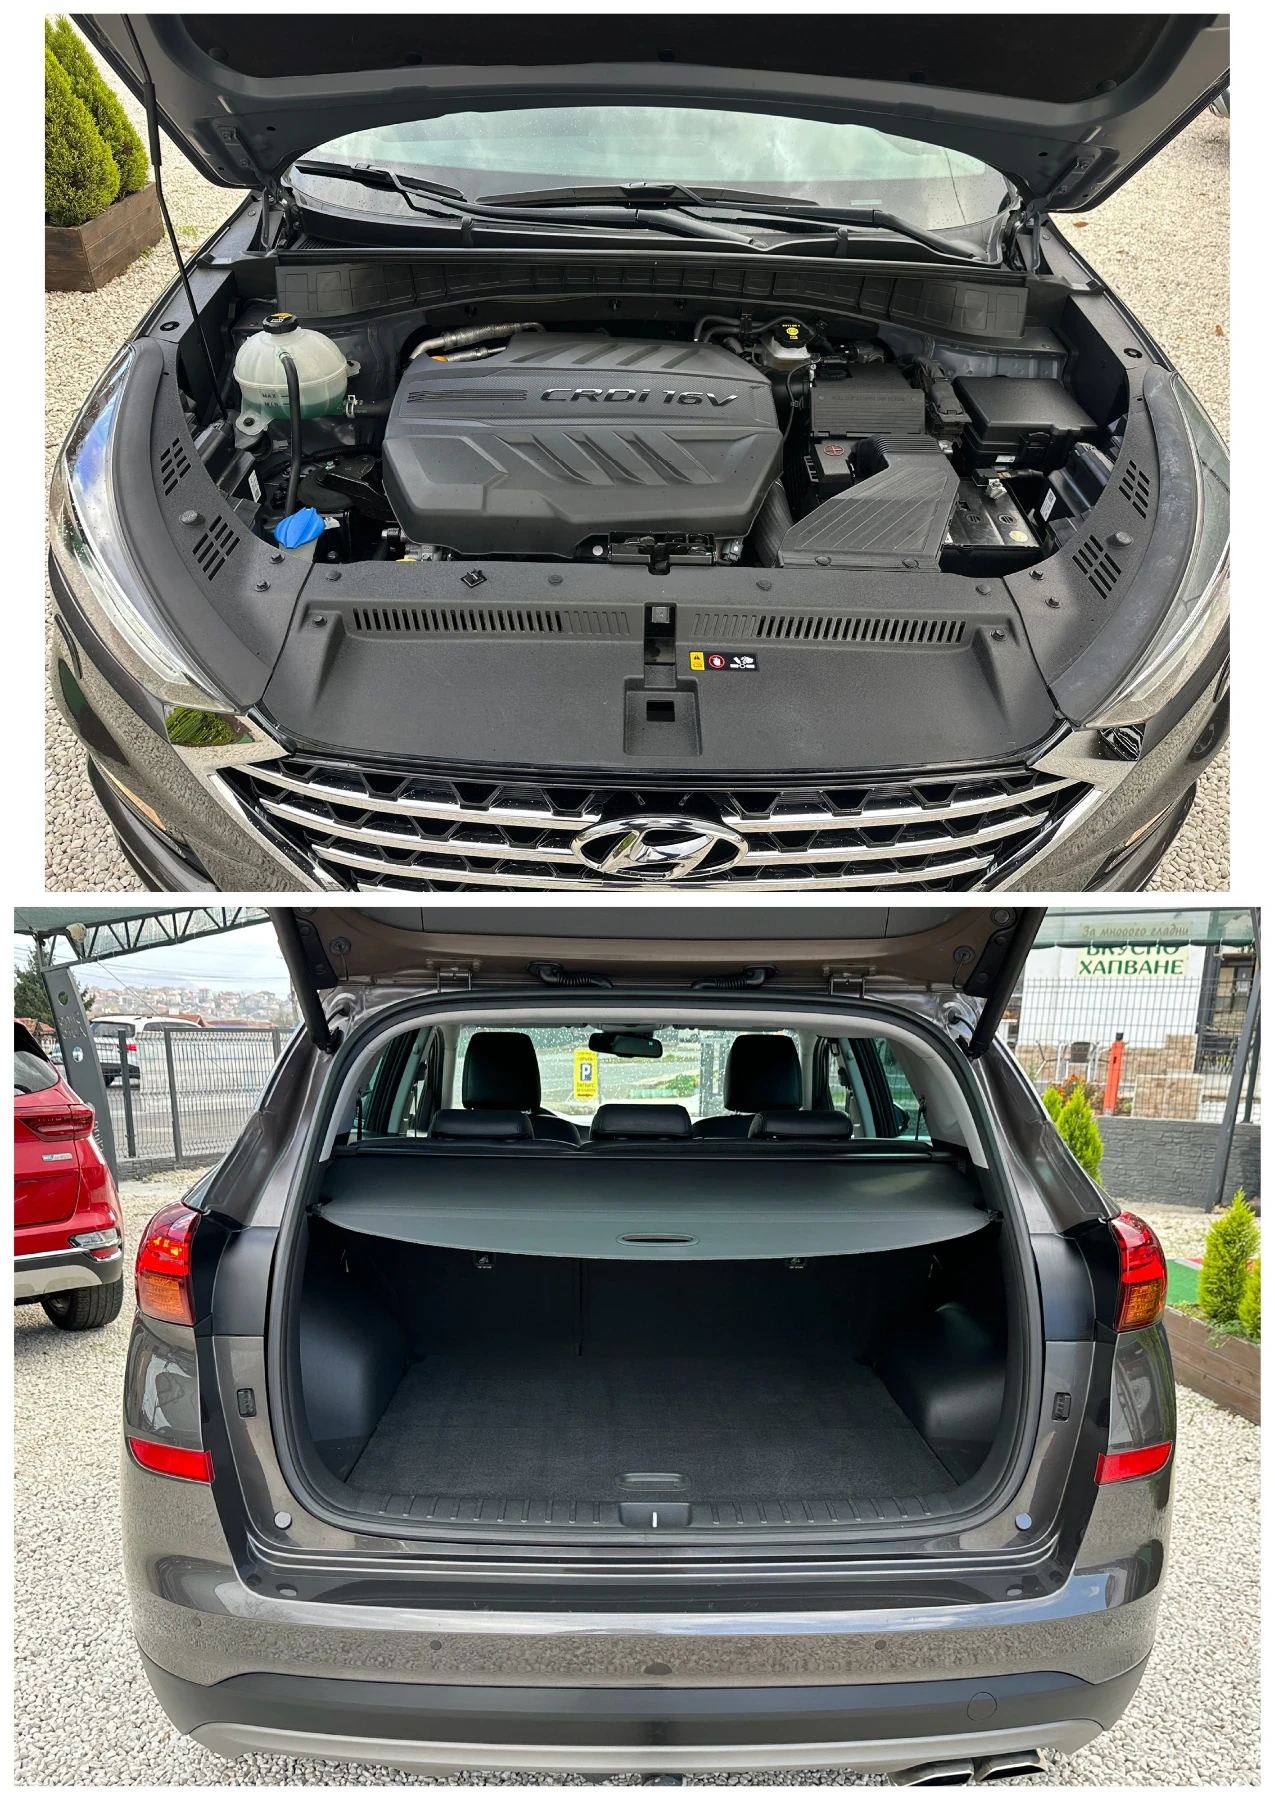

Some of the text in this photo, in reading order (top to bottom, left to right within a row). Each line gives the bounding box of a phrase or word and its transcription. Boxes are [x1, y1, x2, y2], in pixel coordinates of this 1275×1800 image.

[662, 389, 739, 407] 16V
[1082, 925, 1096, 937] За
[1150, 923, 1189, 936] гладни
[1079, 959, 1184, 975] ХАПВАНЕ
[581, 1064, 591, 1080] P
